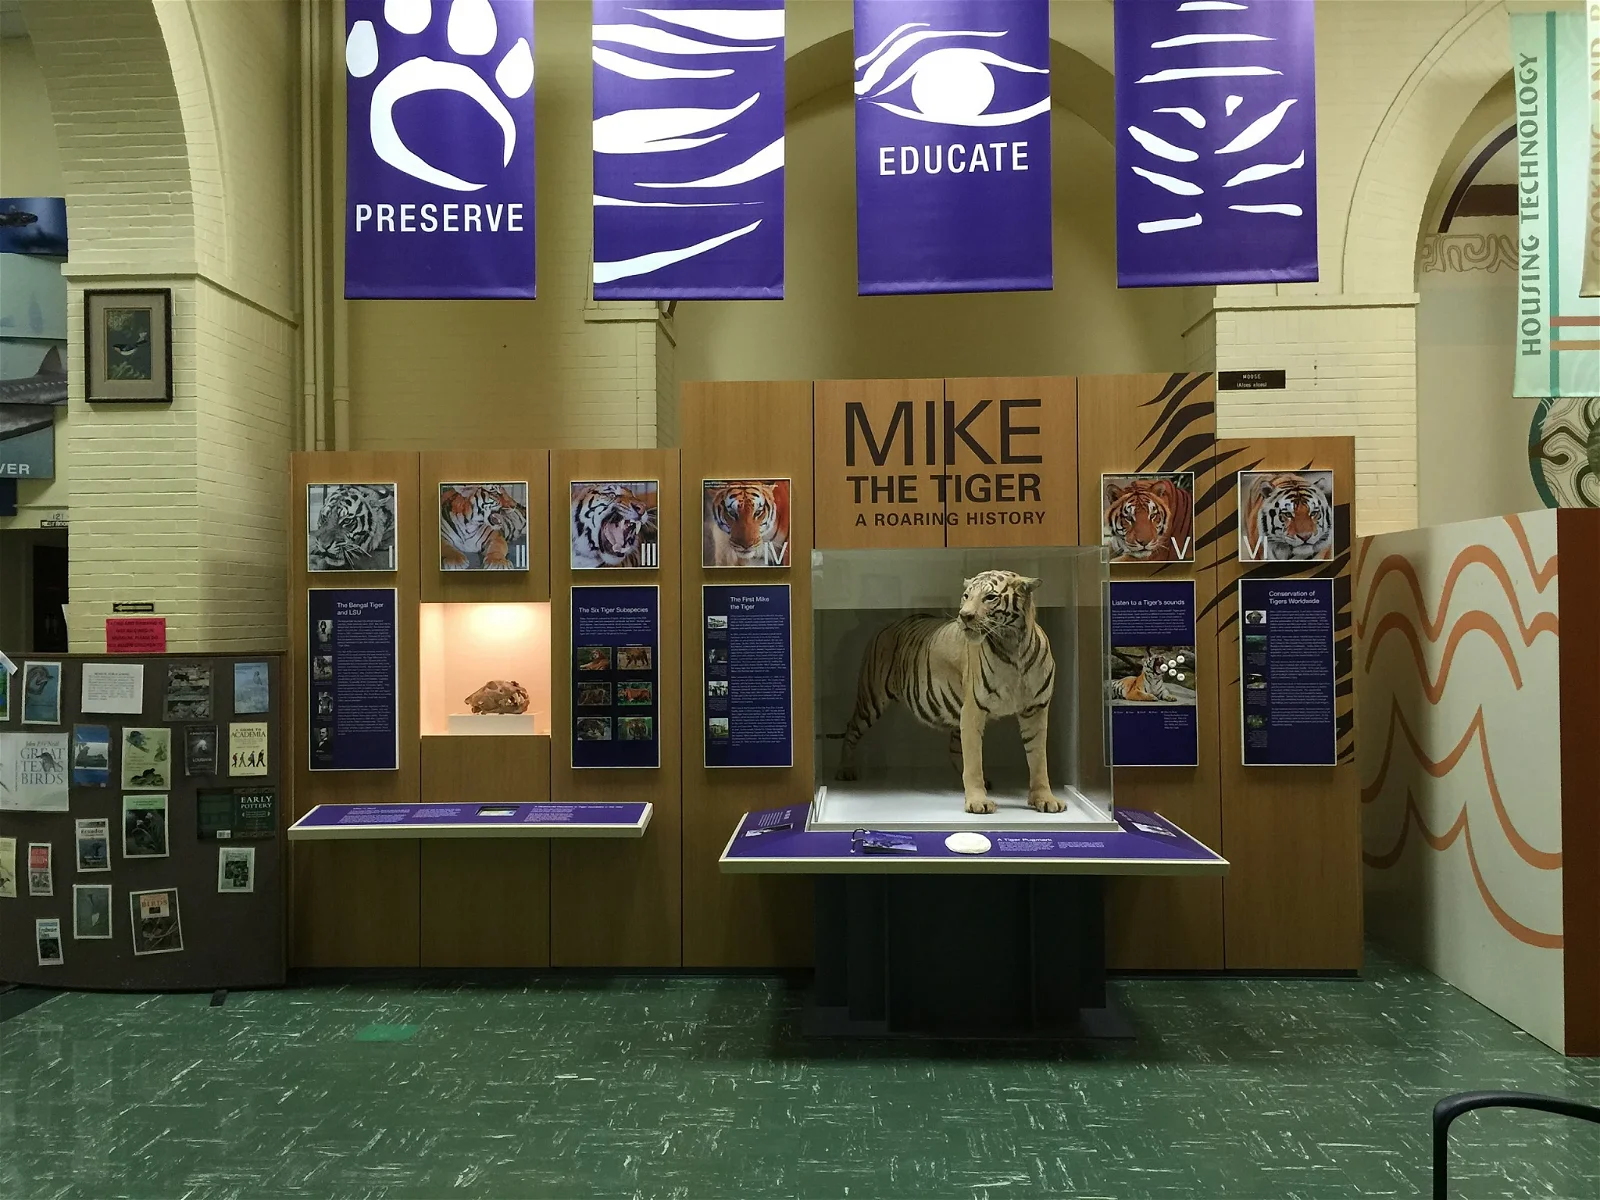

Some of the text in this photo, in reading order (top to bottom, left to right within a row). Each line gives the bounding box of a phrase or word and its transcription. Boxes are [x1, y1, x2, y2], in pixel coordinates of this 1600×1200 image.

[878, 141, 1029, 176] EDUCATE
[1519, 52, 1541, 356] HOUSING TECHNOLOGY
[355, 202, 524, 233] PRESERVE
[846, 398, 1042, 466] MIKE
[846, 473, 1042, 504] THE TIGER
[855, 511, 1046, 526] A ROARING HISTORY
[515, 544, 526, 567] II
[640, 543, 657, 566] III
[764, 542, 786, 566] IV
[1171, 536, 1191, 560] V
[1243, 536, 1268, 560] VI
[22, 773, 64, 784] BIRDS
